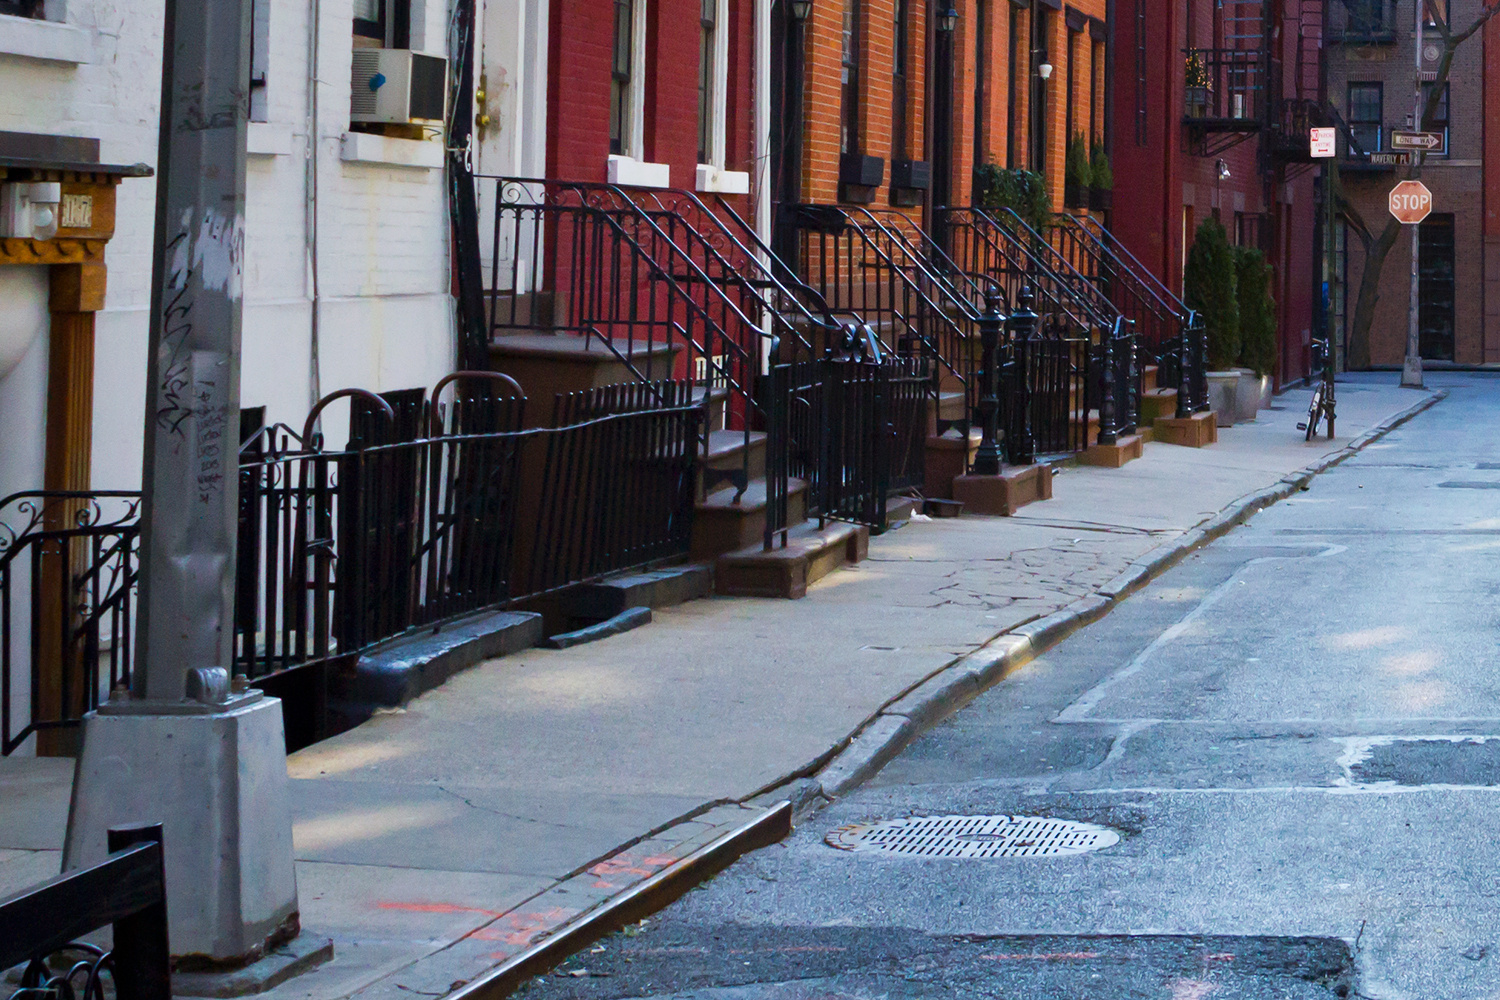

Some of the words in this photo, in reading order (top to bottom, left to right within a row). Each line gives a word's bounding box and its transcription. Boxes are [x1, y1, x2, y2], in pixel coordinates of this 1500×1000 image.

[1400, 135, 1414, 144] ONE
[1420, 136, 1435, 145] WAY
[1371, 153, 1397, 165] WAVERLY
[1400, 153, 1408, 164] PL
[1392, 194, 1429, 210] STOP
